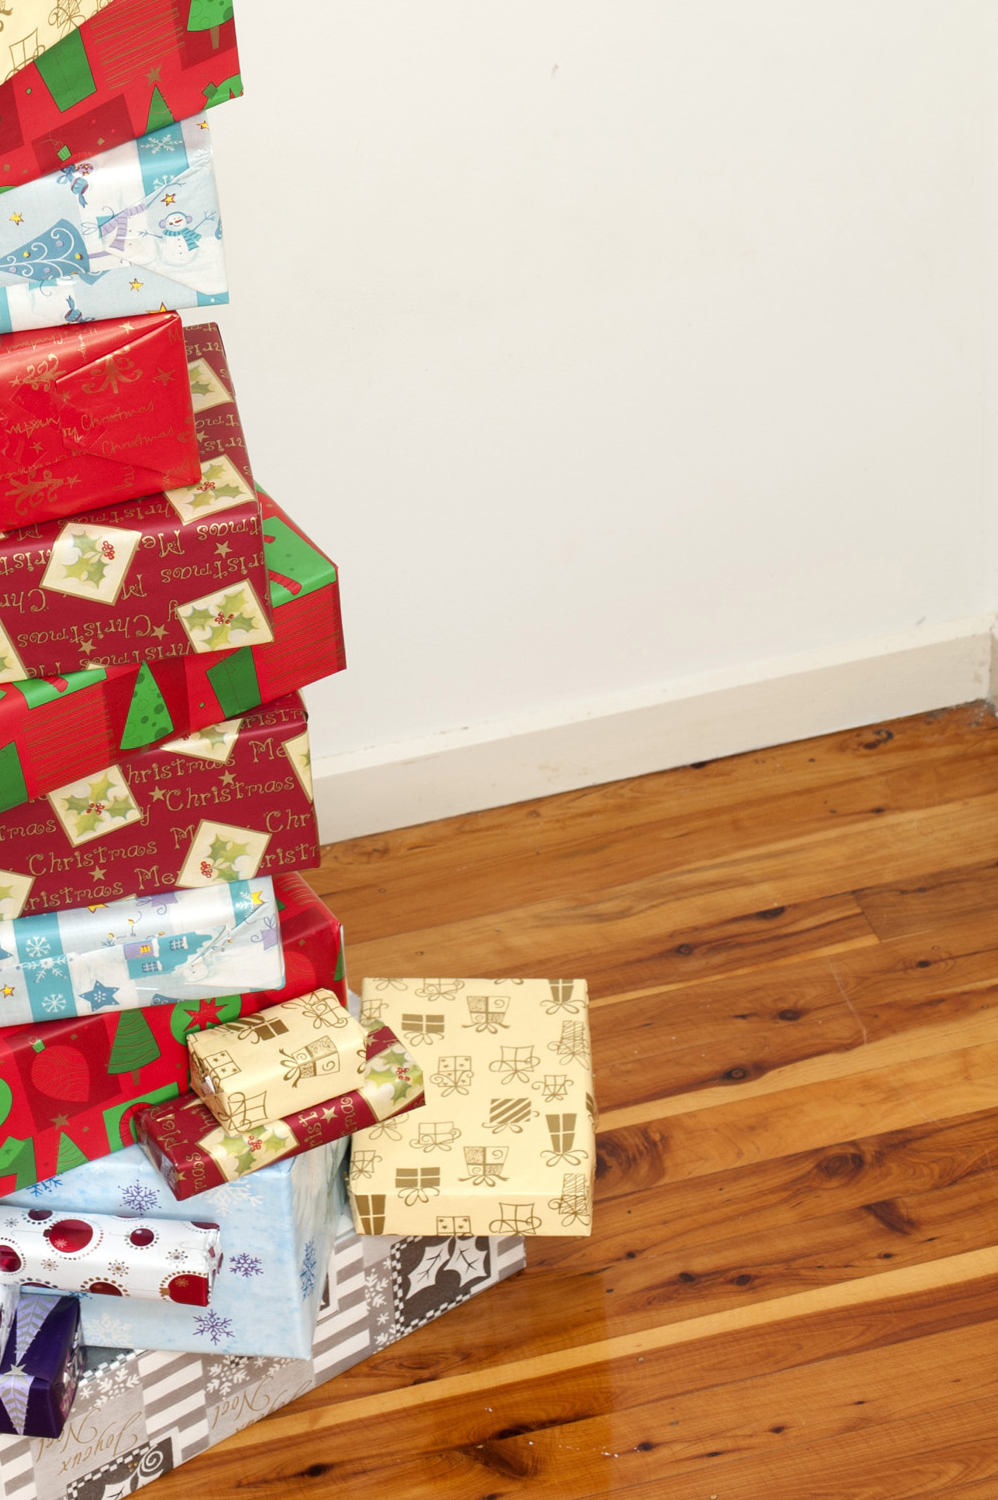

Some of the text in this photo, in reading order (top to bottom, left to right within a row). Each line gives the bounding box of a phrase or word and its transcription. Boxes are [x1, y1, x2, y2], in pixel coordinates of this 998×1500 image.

[81, 401, 155, 431] Christmas
[101, 426, 175, 456] Christmas
[17, 614, 153, 648] Christmas
[165, 775, 295, 812] Christmas
[26, 840, 158, 876] Christmas
[211, 1375, 274, 1430] Noel
[57, 1410, 143, 1476] Joyeux
